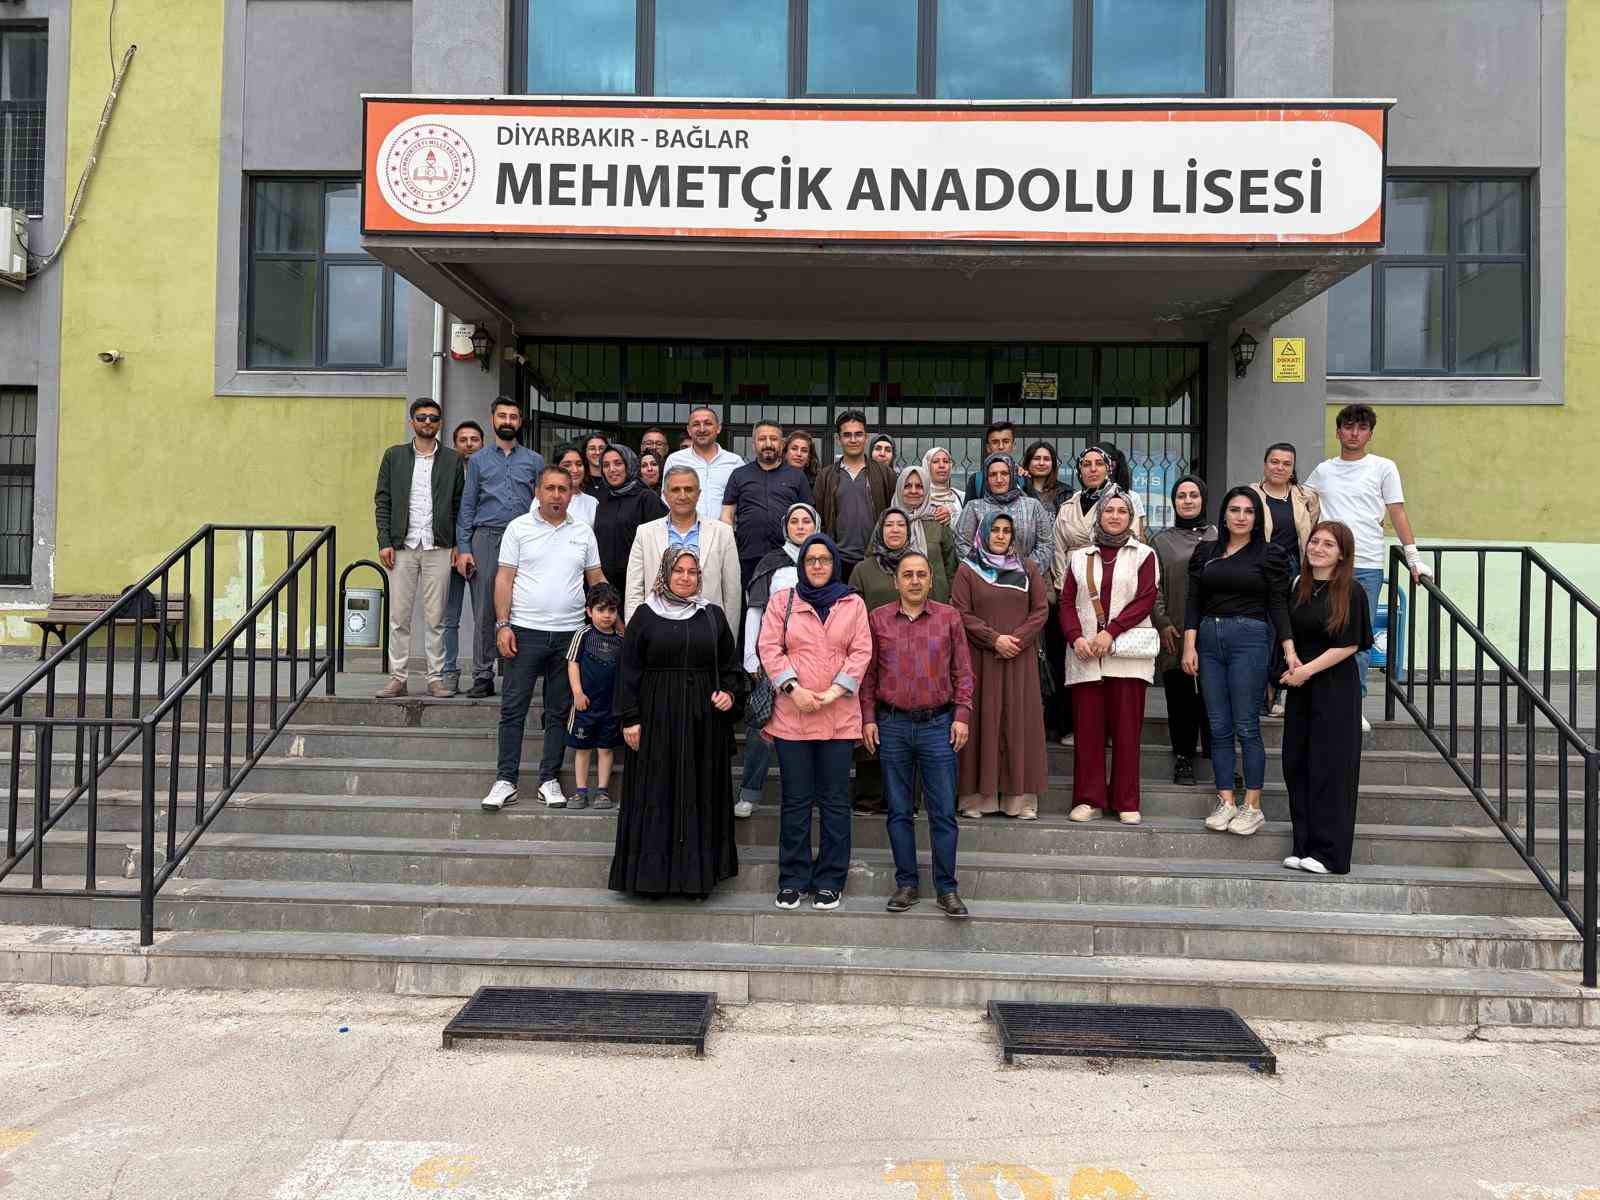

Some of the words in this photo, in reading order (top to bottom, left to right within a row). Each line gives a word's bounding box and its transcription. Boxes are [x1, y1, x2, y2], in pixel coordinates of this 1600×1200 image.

[496, 123, 635, 148] DİYARBAKIR
[655, 125, 750, 149] BAĞLAR
[495, 155, 833, 223] MEHMETÇİK
[846, 167, 1133, 214] ANADOLU
[1152, 157, 1322, 214] LİSESİ
